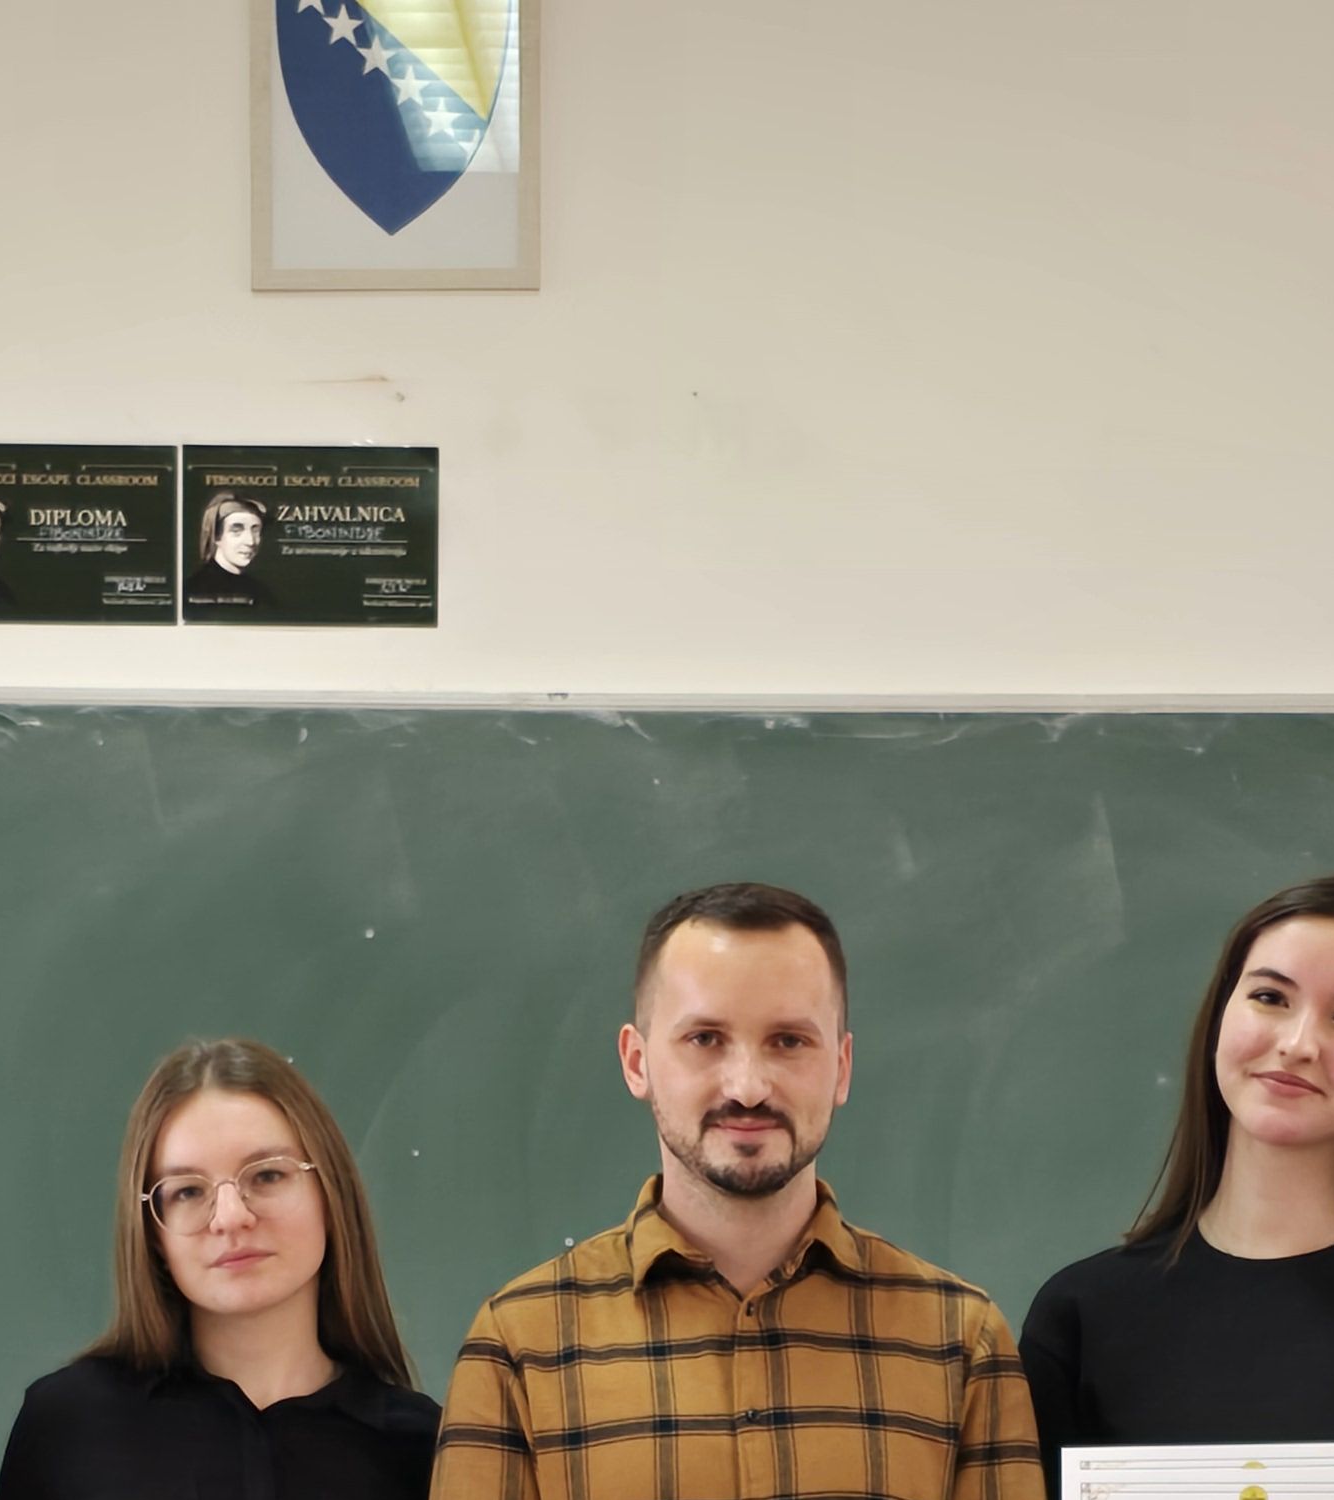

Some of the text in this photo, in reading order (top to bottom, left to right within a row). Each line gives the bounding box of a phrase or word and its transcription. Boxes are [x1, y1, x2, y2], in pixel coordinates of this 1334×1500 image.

[22, 473, 71, 486] ESCAPE
[76, 474, 159, 487] CLASSROOM
[205, 474, 420, 488] FIBONACCI ESCAPE CLASSROOM
[29, 508, 127, 527] DIPLOMA
[277, 505, 406, 522] ZAHVALNICA
